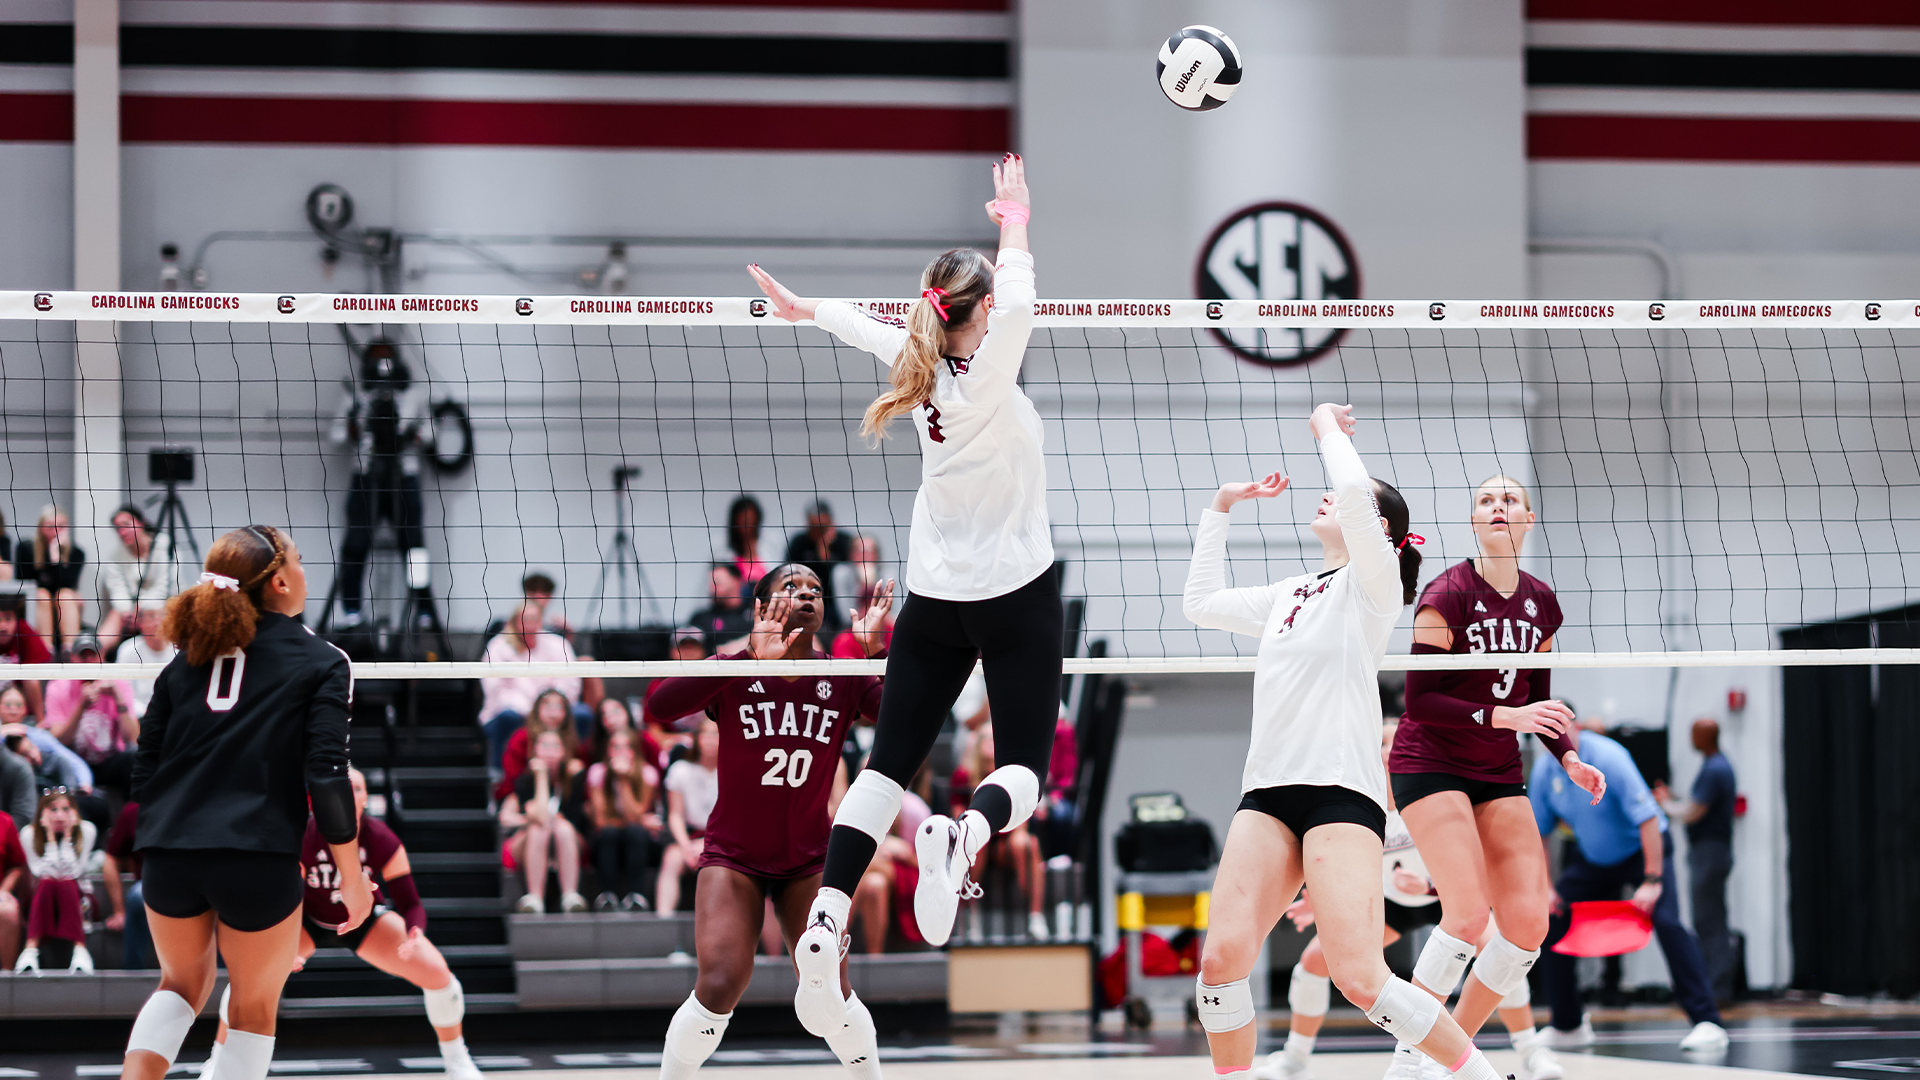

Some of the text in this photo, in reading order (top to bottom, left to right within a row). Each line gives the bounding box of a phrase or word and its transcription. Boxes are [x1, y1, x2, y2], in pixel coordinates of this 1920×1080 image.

[1175, 60, 1202, 92] Wilson
[92, 295, 240, 309] CAROLINA GAMECOCKS
[333, 298, 479, 311] CAROLINA GAMECOCKS
[570, 301, 713, 313] CAROLINA GAMECOCKS
[1033, 303, 1171, 316] CAROLINA GAMECOCKS
[1258, 304, 1394, 317] CAROLINA GAMECOCKS
[1480, 305, 1614, 317] CAROLINA GAMECOCKS
[1699, 306, 1832, 317] CAROLINA GAMECOCKS
[206, 646, 246, 712] 0
[1491, 668, 1517, 699] 3
[739, 701, 839, 745] STATE
[761, 748, 813, 788] 20
